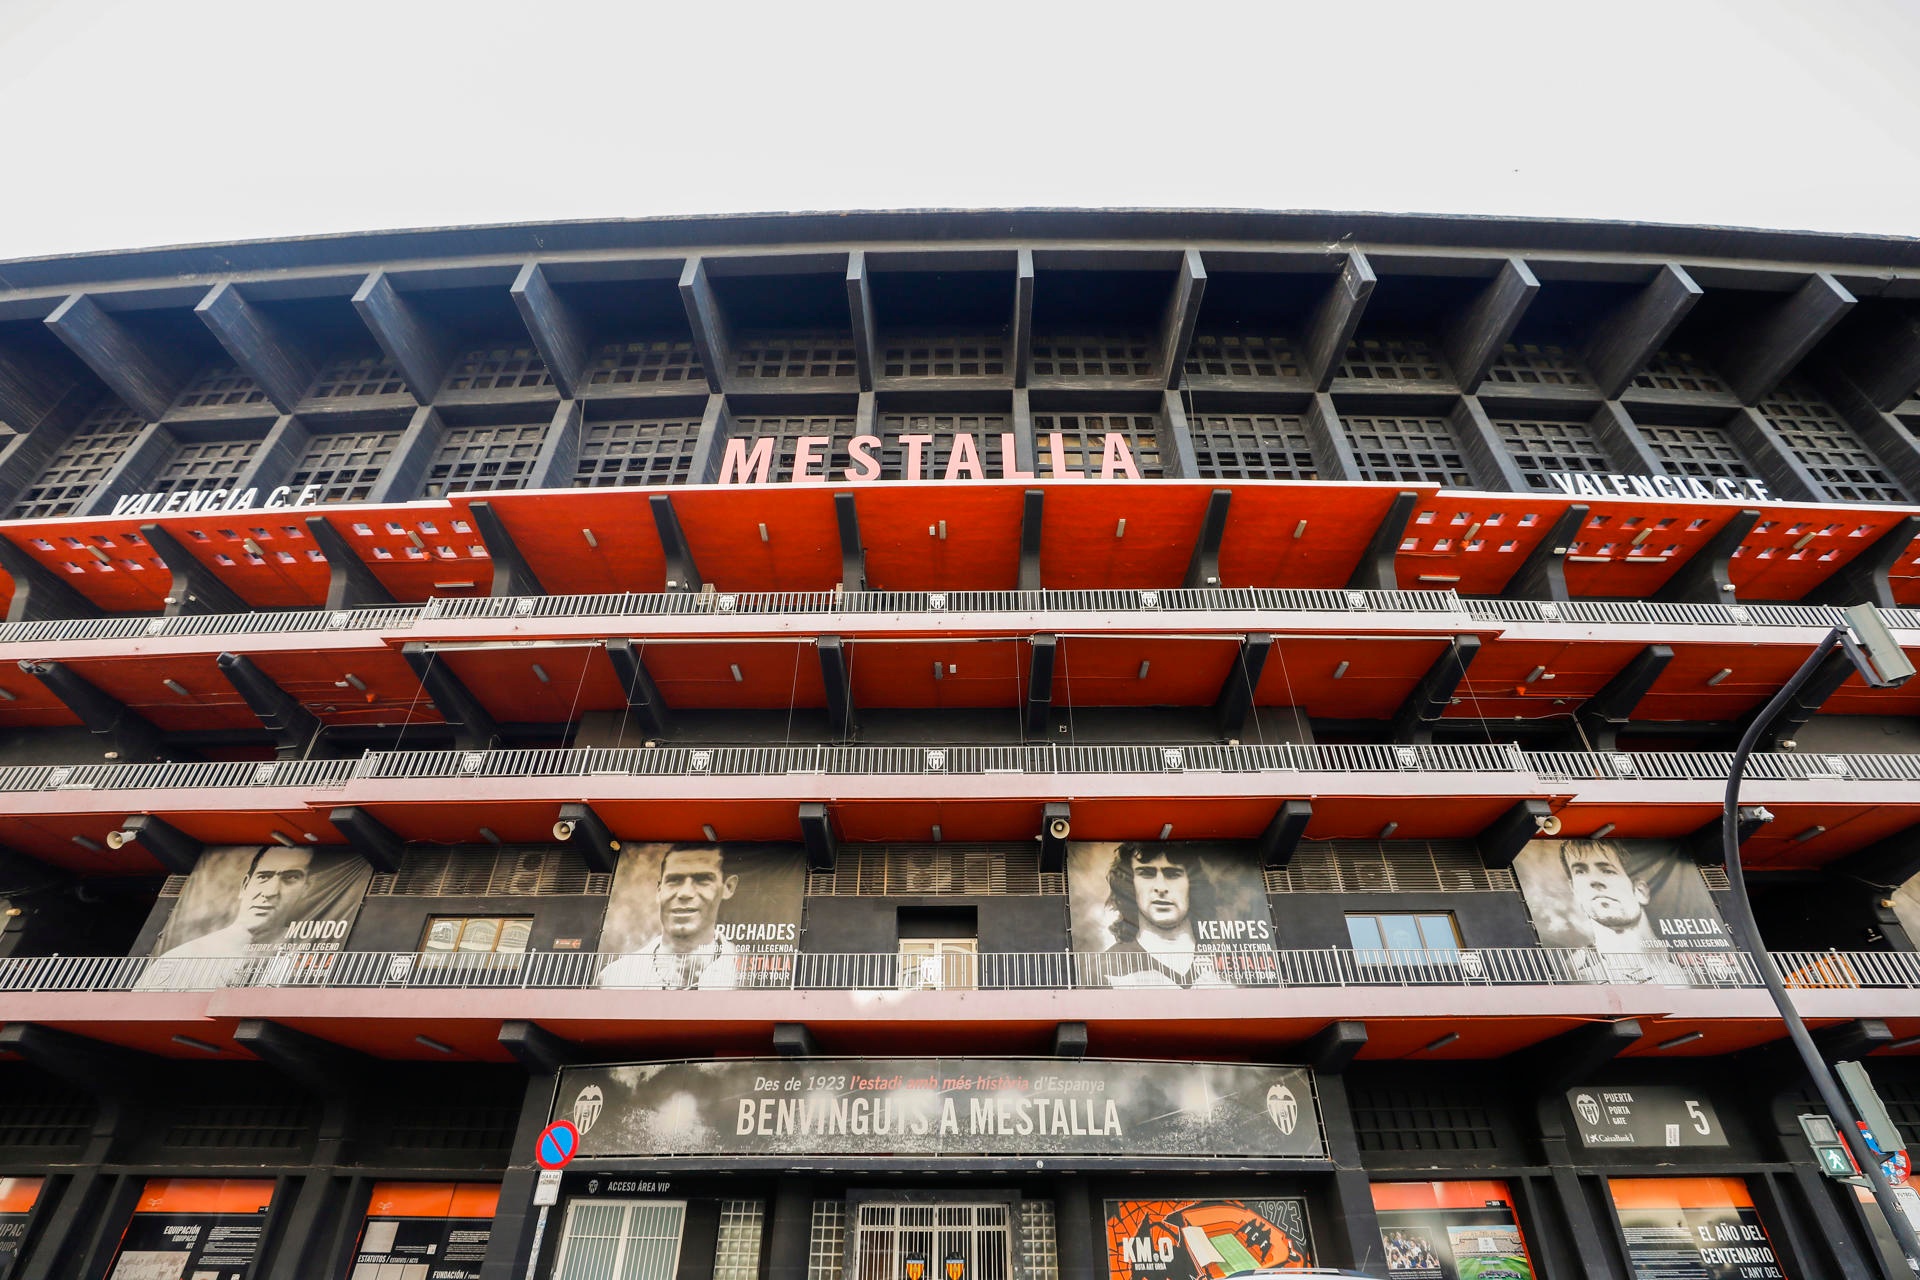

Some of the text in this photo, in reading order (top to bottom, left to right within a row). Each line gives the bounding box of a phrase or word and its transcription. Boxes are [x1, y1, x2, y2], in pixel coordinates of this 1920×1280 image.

[718, 432, 1141, 485] MESTALLA
[1550, 472, 1714, 500] VALENCIA
[111, 487, 258, 516] VALENCIA
[284, 919, 348, 939] MUNDO
[714, 923, 796, 941] PUCHADES
[1197, 919, 1270, 940] KEMPES
[1658, 918, 1723, 935] ALBELDA
[311, 942, 340, 951] LEGEND
[735, 943, 752, 953] COR
[752, 943, 756, 953] I
[757, 943, 794, 953] LLEGENDA
[1197, 942, 1272, 952] CORAZÓN Y LEYENDA
[1674, 939, 1689, 948] COR
[1693, 938, 1730, 948] LLEGENDA
[754, 1075, 1105, 1094] Des de 1923 l'estadi amb més història d'Espanya
[1603, 1093, 1634, 1103] PUERTA
[737, 1097, 1122, 1136] BENVINGUTS A MESTALLA
[1608, 1106, 1631, 1115] PORTA
[1684, 1100, 1711, 1136] 5
[1612, 1117, 1627, 1125] GATE
[1599, 1134, 1631, 1143] CaixaBank
[607, 1179, 671, 1193] ACCESO ÁREA VIP
[1258, 1200, 1306, 1243] 1923
[163, 1224, 201, 1235] EQUIPACIÓN
[1697, 1225, 1716, 1242] EL
[1717, 1222, 1740, 1242] AÑO
[1740, 1225, 1766, 1241] DEL
[357, 1255, 386, 1263] ESTATUTOS
[1701, 1247, 1775, 1264] CENTENARIO
[432, 1269, 464, 1280] FUNDACIÓN
[1739, 1266, 1783, 1279] L'ANY DEL
